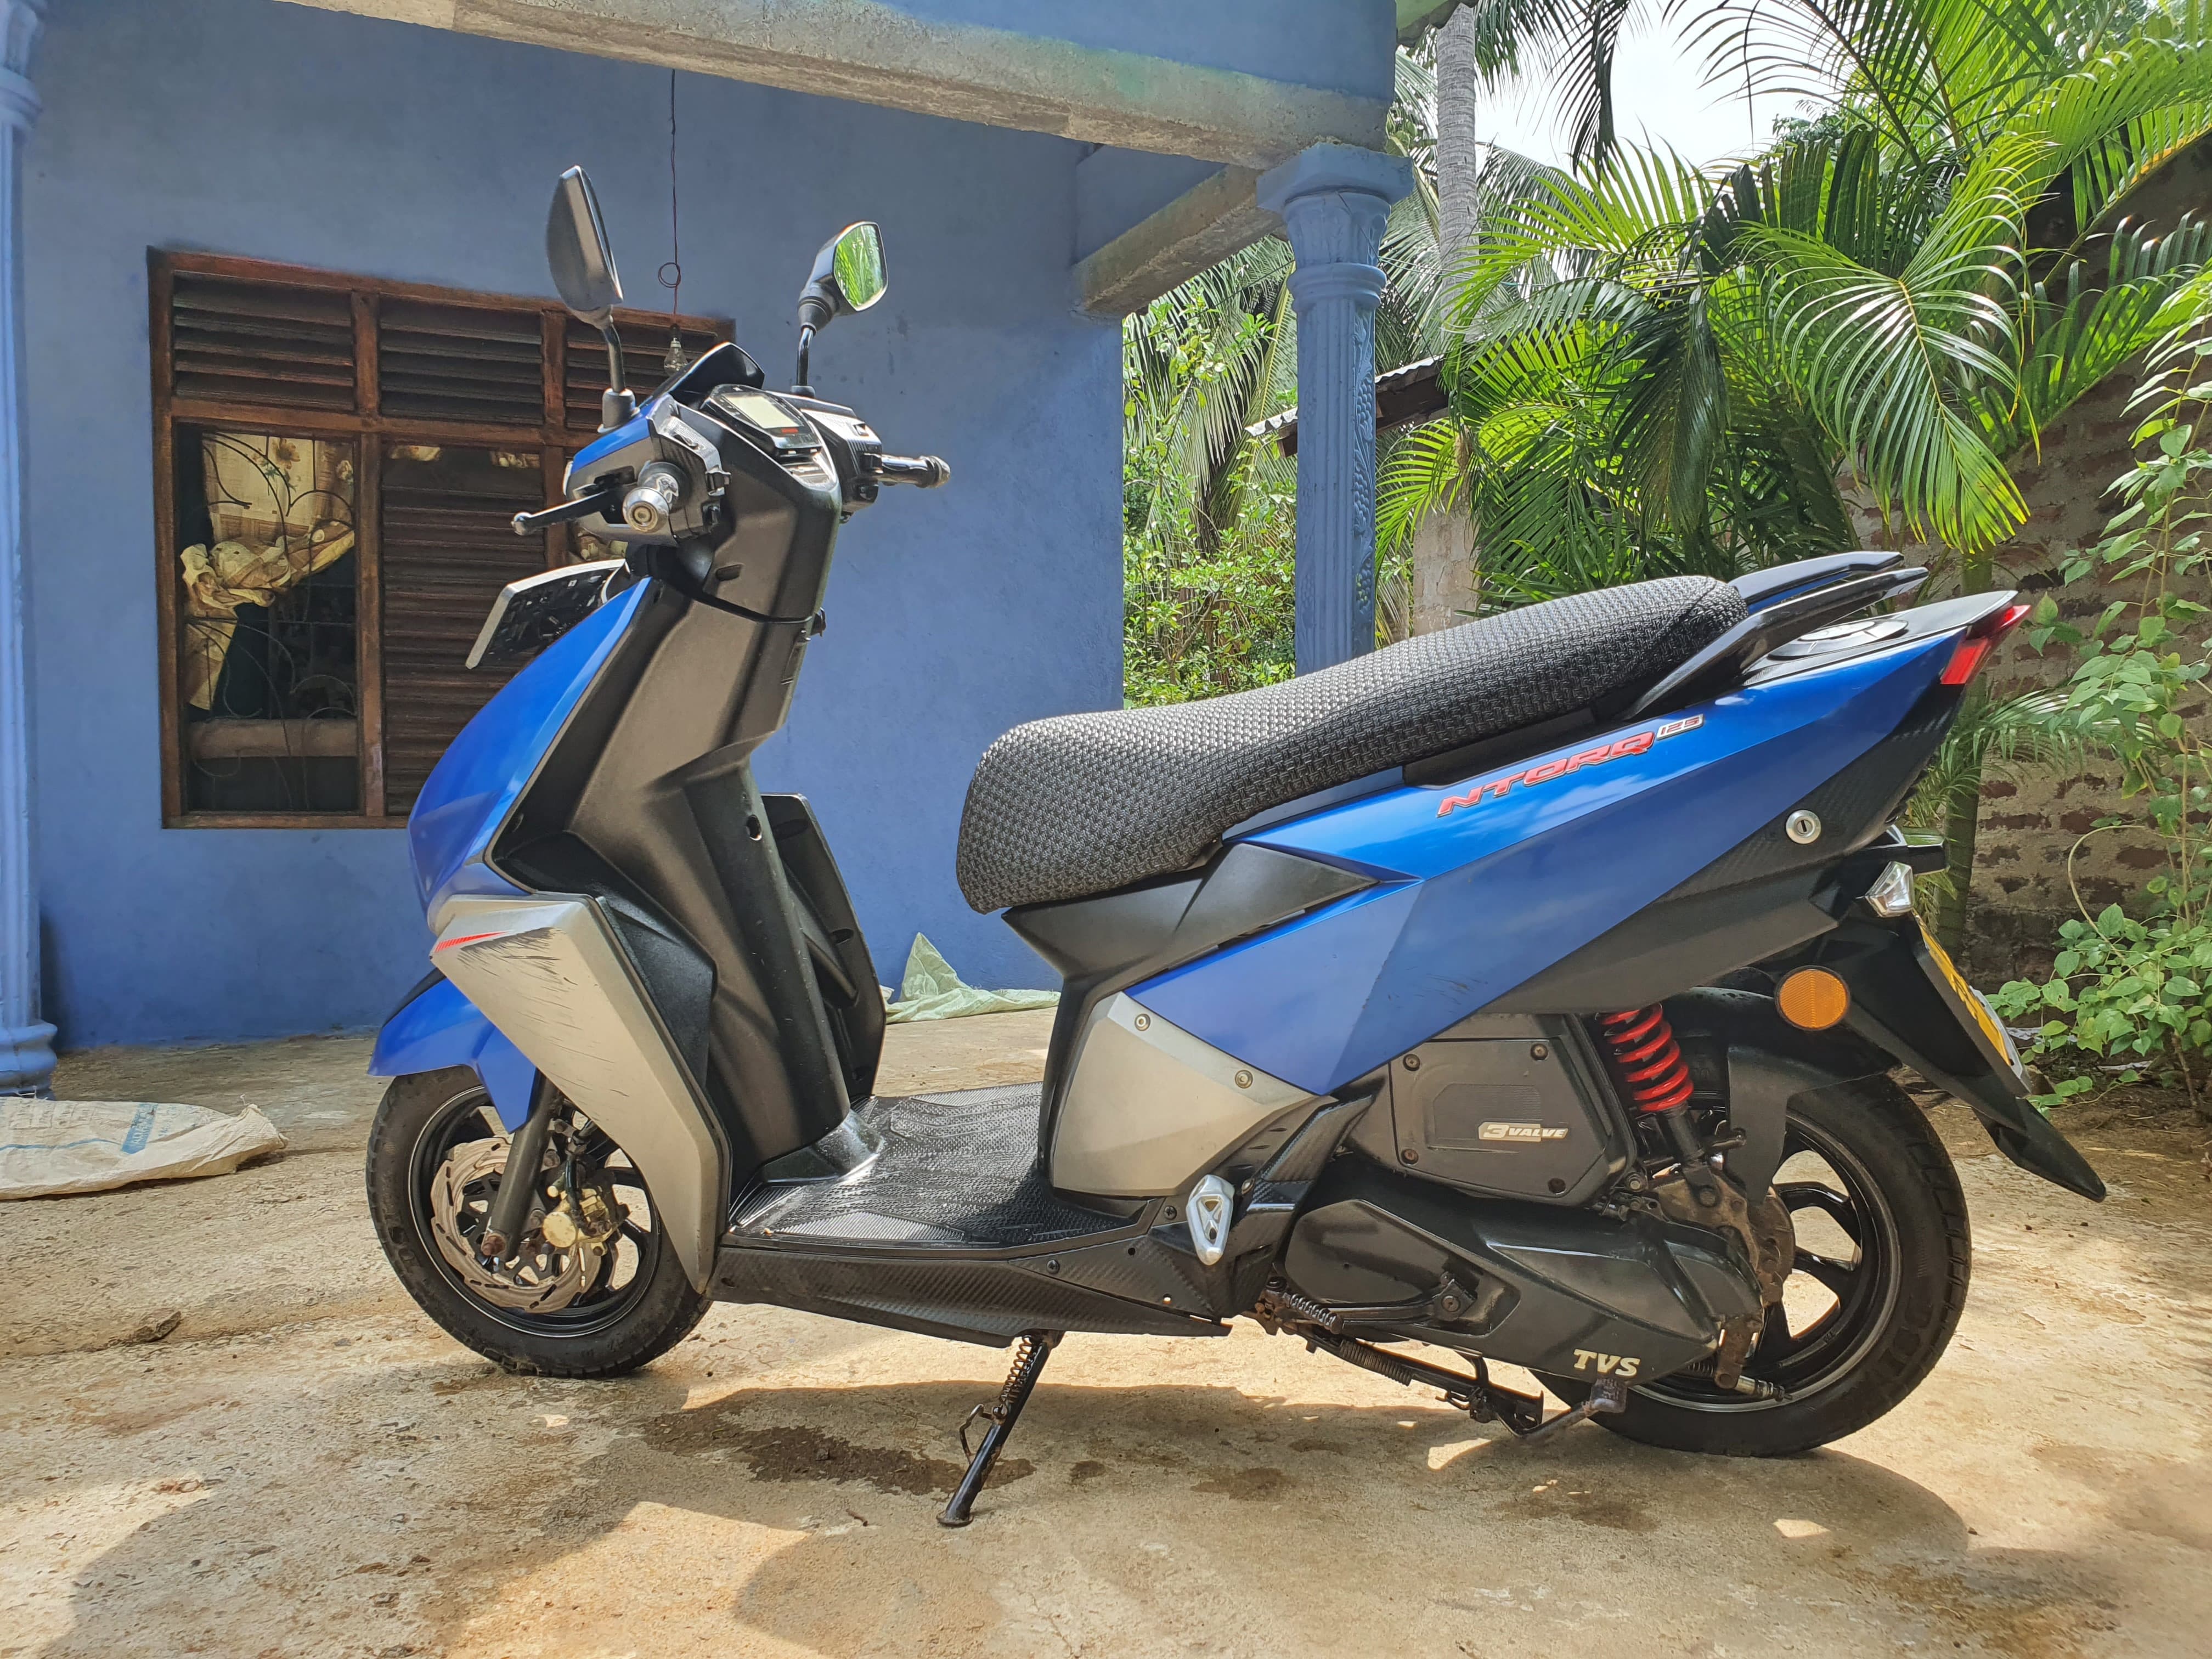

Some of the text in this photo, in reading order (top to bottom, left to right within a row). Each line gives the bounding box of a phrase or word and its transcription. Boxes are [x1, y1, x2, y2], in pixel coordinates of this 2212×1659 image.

[1436, 715, 1701, 817] NTORQ 125
[1573, 1348, 1641, 1377] TVS
